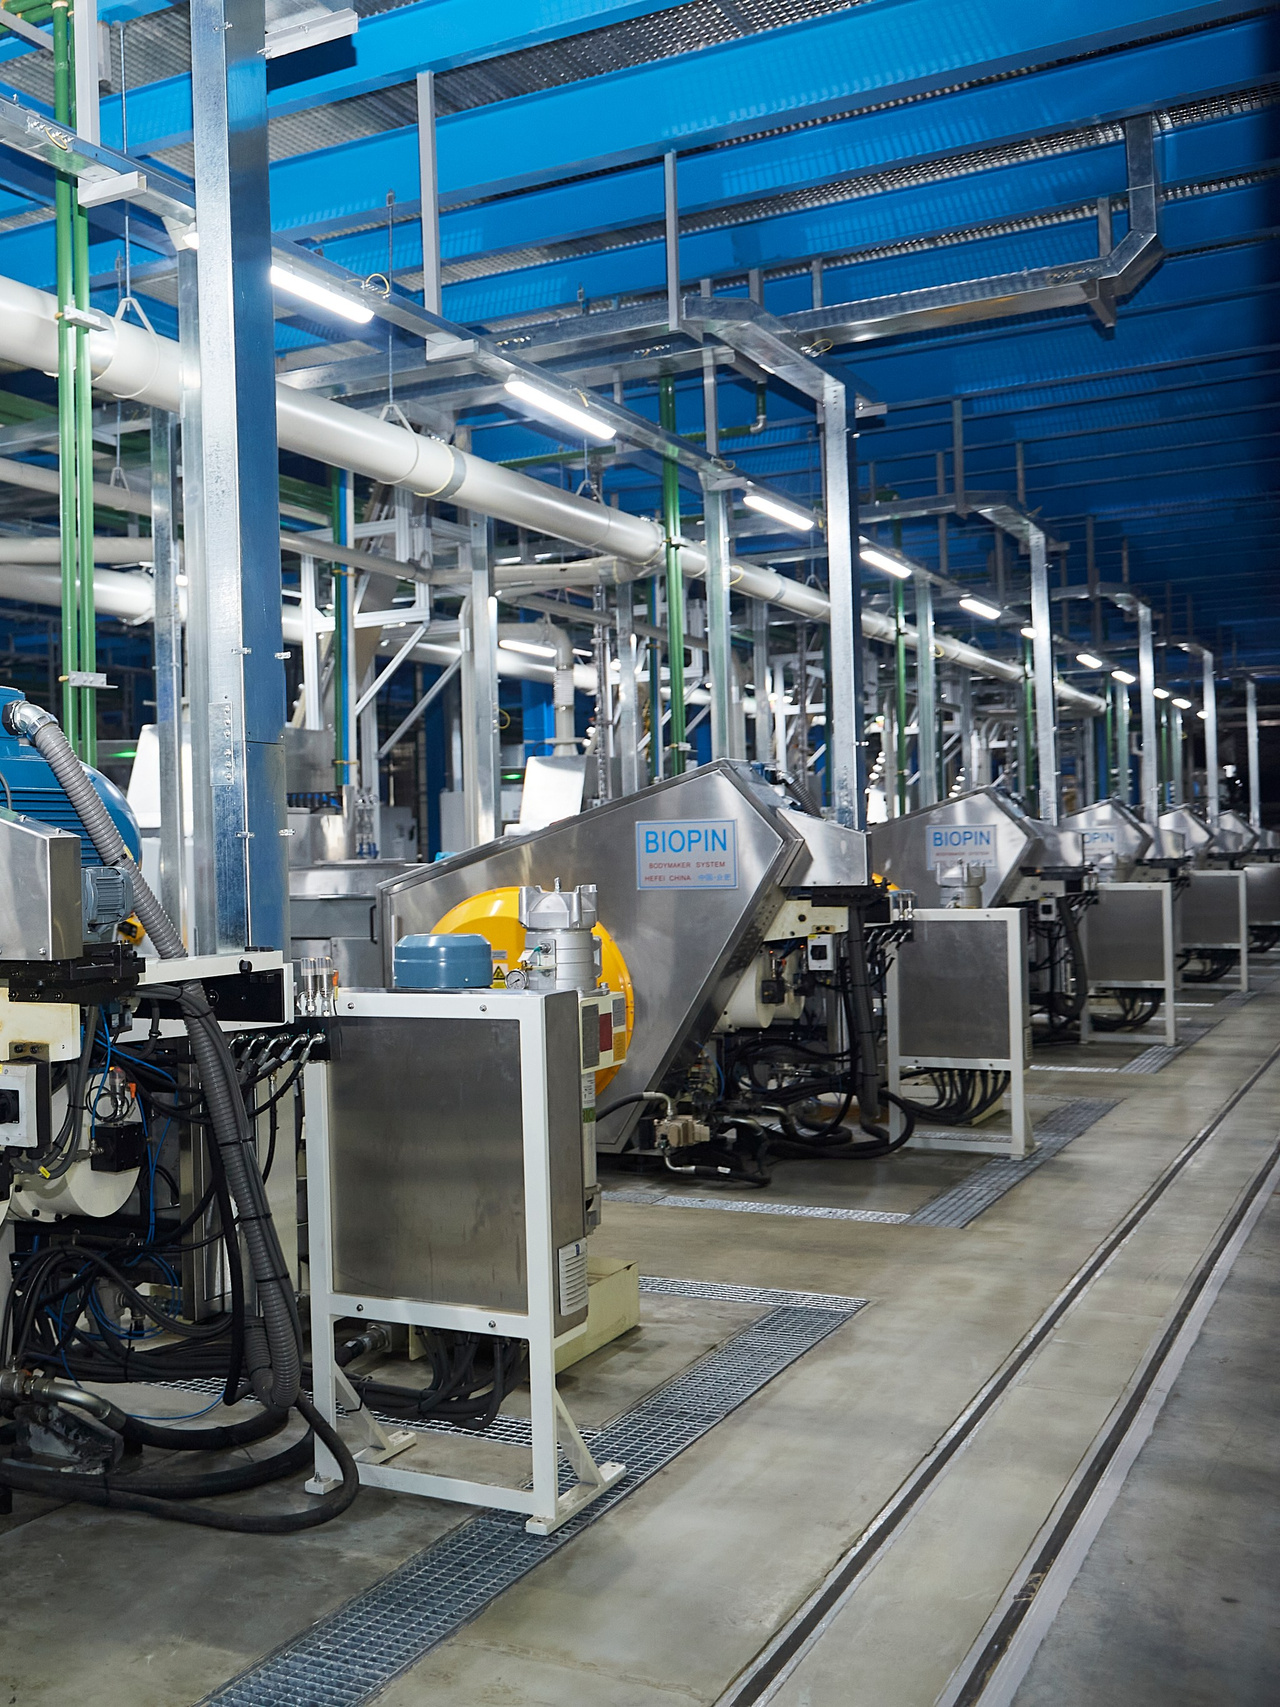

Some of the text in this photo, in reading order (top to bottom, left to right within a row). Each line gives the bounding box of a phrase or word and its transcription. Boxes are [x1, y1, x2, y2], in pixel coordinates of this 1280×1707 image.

[645, 829, 727, 853] BIOPIN
[933, 831, 991, 847] BIOPIN
[648, 861, 691, 869] BODYMAKER
[644, 874, 666, 882] HEFEI
[668, 874, 692, 882] CHINA
